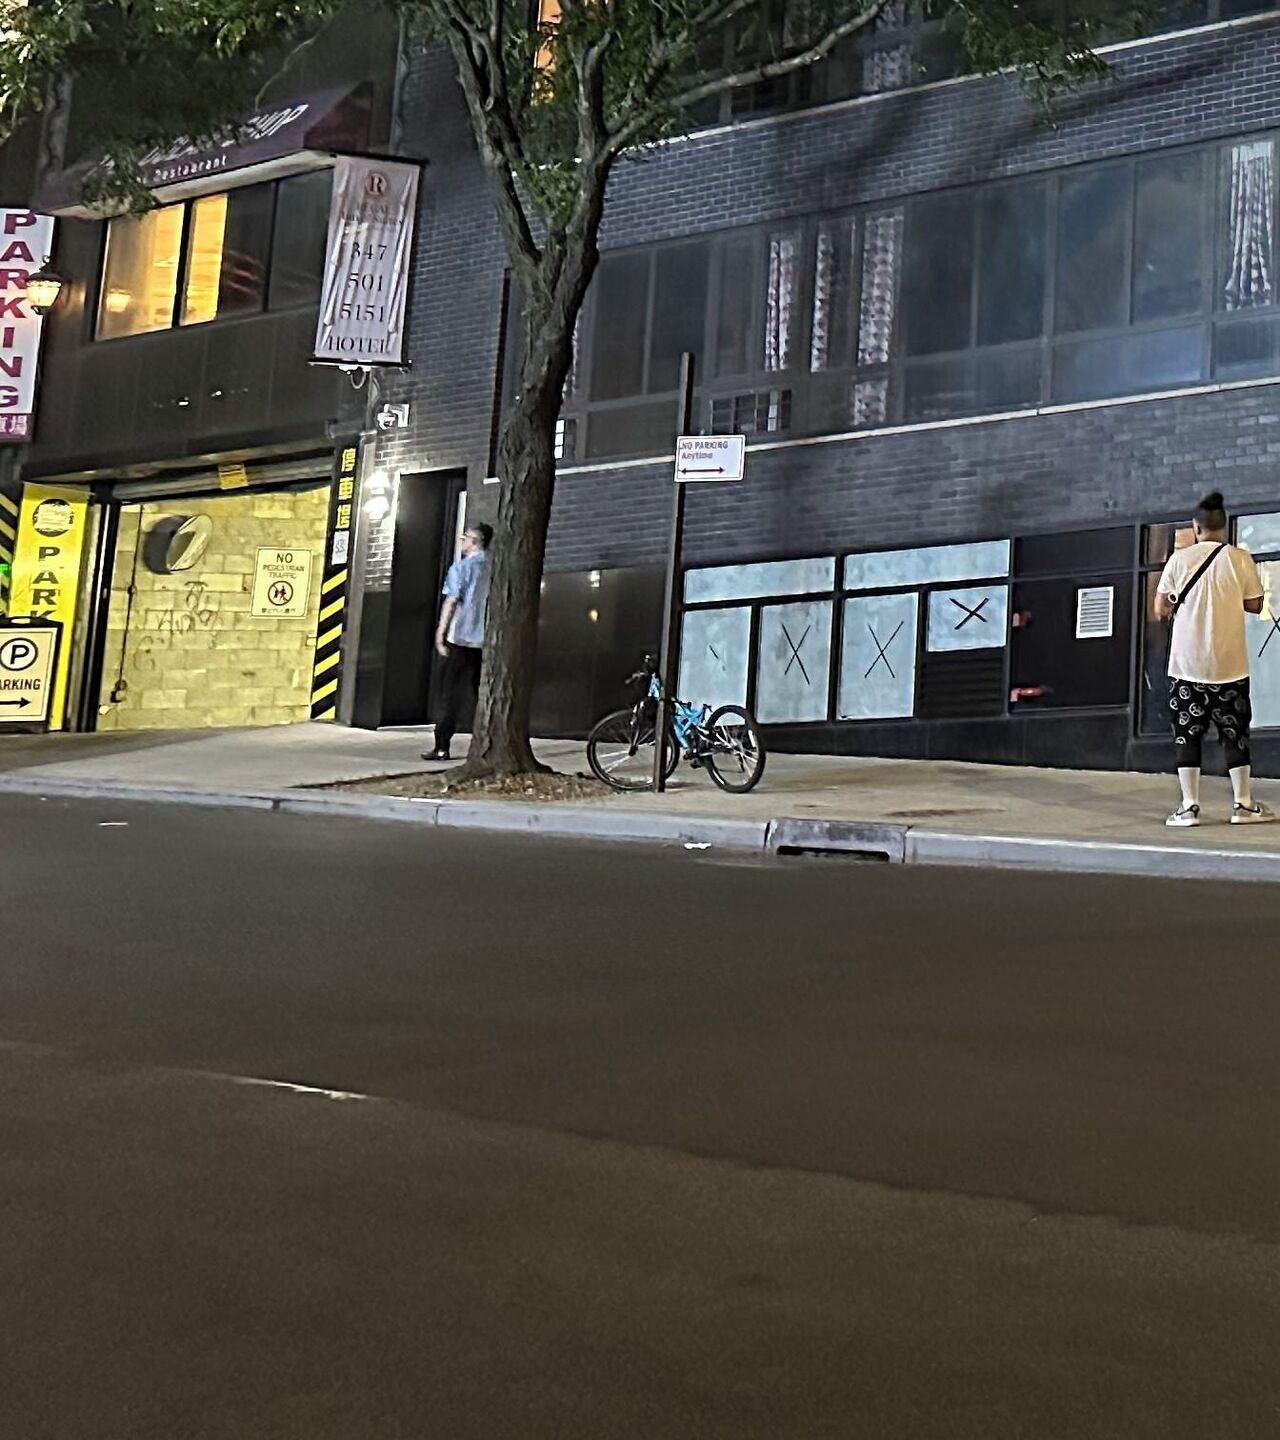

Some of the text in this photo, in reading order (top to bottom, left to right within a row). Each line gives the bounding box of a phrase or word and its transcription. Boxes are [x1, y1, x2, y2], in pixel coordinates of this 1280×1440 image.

[350, 242, 388, 261] 347
[348, 273, 383, 292] 501
[0, 213, 37, 408] PARKING
[340, 303, 384, 323] 5151
[328, 335, 390, 354] HOTEL
[680, 440, 728, 450] NO PARKING
[277, 553, 293, 563] NO
[10, 644, 29, 666] P
[0, 678, 40, 691] ARKING
